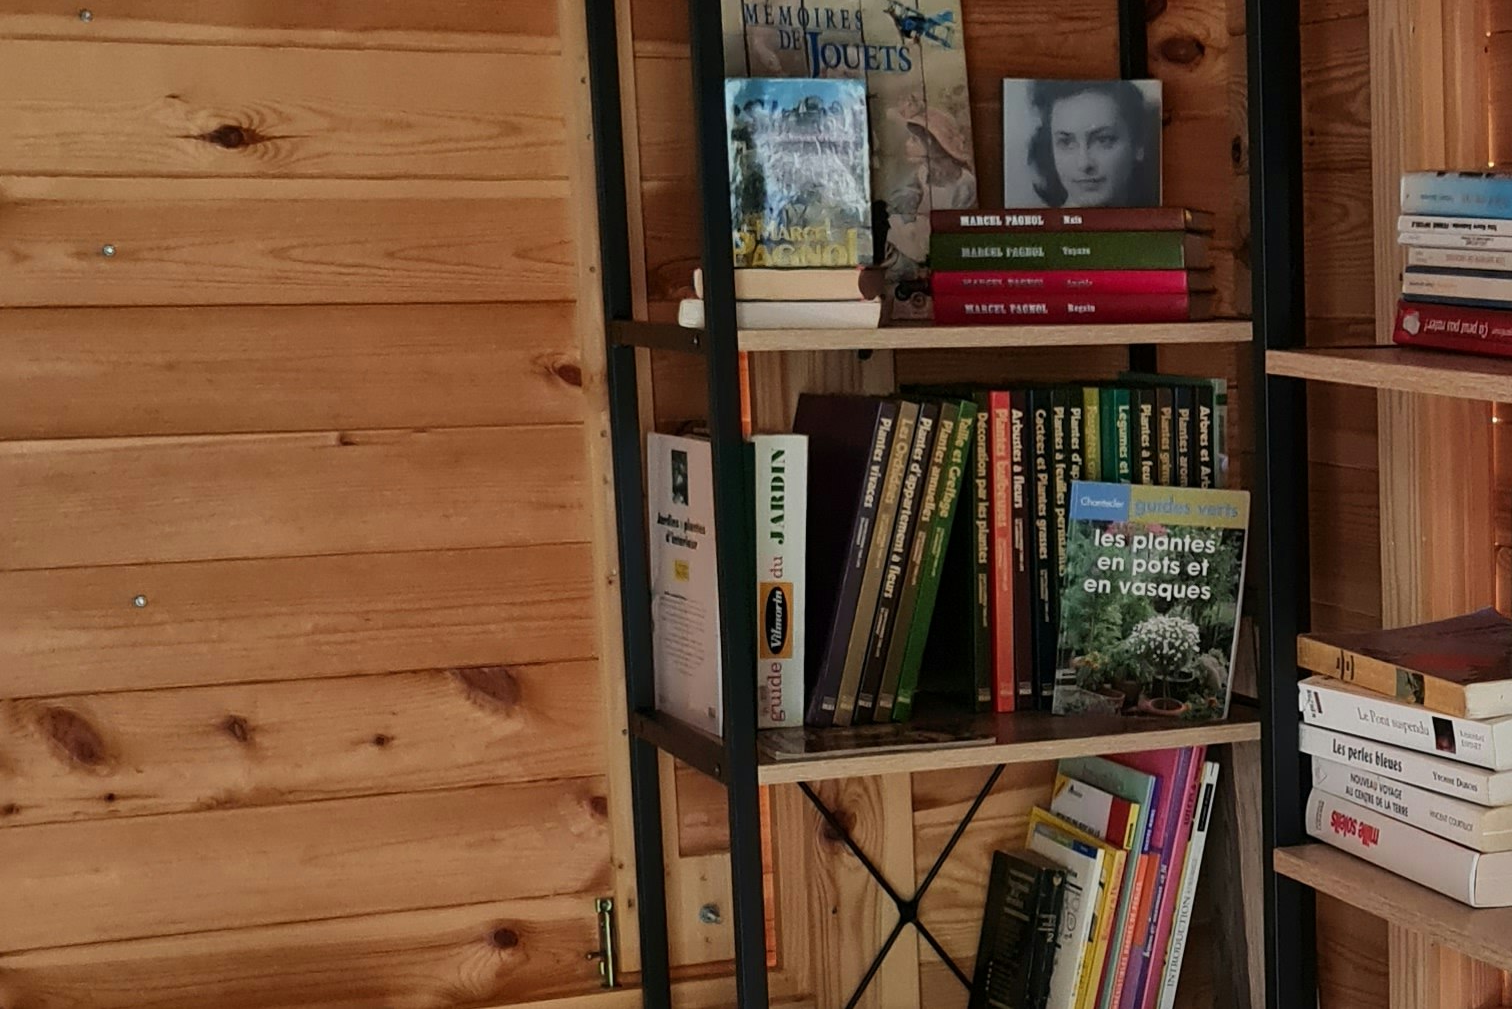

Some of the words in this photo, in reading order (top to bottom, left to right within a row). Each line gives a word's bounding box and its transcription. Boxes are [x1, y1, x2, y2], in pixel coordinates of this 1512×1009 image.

[780, 29, 800, 51] DE
[806, 31, 912, 79] JOUETS
[960, 216, 1002, 227] MARCEL
[1005, 215, 1045, 226] PAGNOL
[961, 247, 1003, 258] MARCEL
[1006, 246, 1045, 257] PAGNOL
[964, 304, 1007, 315] MARCEL
[1009, 304, 1048, 315] PAGNOL
[873, 416, 892, 462] Plantes
[914, 416, 933, 462] Plantes
[976, 412, 989, 478] Décoration
[1011, 408, 1024, 462] Arbustes
[1035, 408, 1047, 456] Cactées
[1053, 406, 1064, 450] Plantes
[1070, 407, 1082, 451] Plantes
[1140, 404, 1152, 454] Plantes
[1160, 406, 1172, 450] Plantes
[1178, 408, 1190, 452] Plantes
[1200, 405, 1211, 443] Arbres
[1200, 447, 1211, 462] et
[770, 448, 786, 545] JARDIN
[864, 465, 882, 509] vivaces
[975, 478, 987, 500] par
[1013, 473, 1024, 509] fleurs
[1037, 473, 1049, 517] Plantes
[1135, 495, 1190, 519] guides
[1197, 501, 1238, 519] verts
[976, 519, 989, 565] plantes
[1094, 529, 1126, 548] les
[1132, 532, 1216, 555] plantes
[770, 556, 783, 579] du
[884, 566, 901, 599] fleurs
[1097, 555, 1125, 571] en
[1132, 556, 1182, 577] pots
[1187, 560, 1209, 577] et
[1084, 578, 1111, 595] en
[1119, 580, 1212, 604] vasques
[770, 590, 784, 649] Vilmorin
[766, 662, 786, 722] guide
[1357, 707, 1368, 721] Le
[1332, 738, 1346, 756] Les
[1347, 744, 1373, 765] perles
[1375, 750, 1402, 773] bleues
[1350, 773, 1378, 792] NOUVEAU
[1378, 780, 1402, 800] VOYAGE
[1392, 802, 1409, 818] TERRE
[1167, 896, 1191, 988] INTRODUCTION
